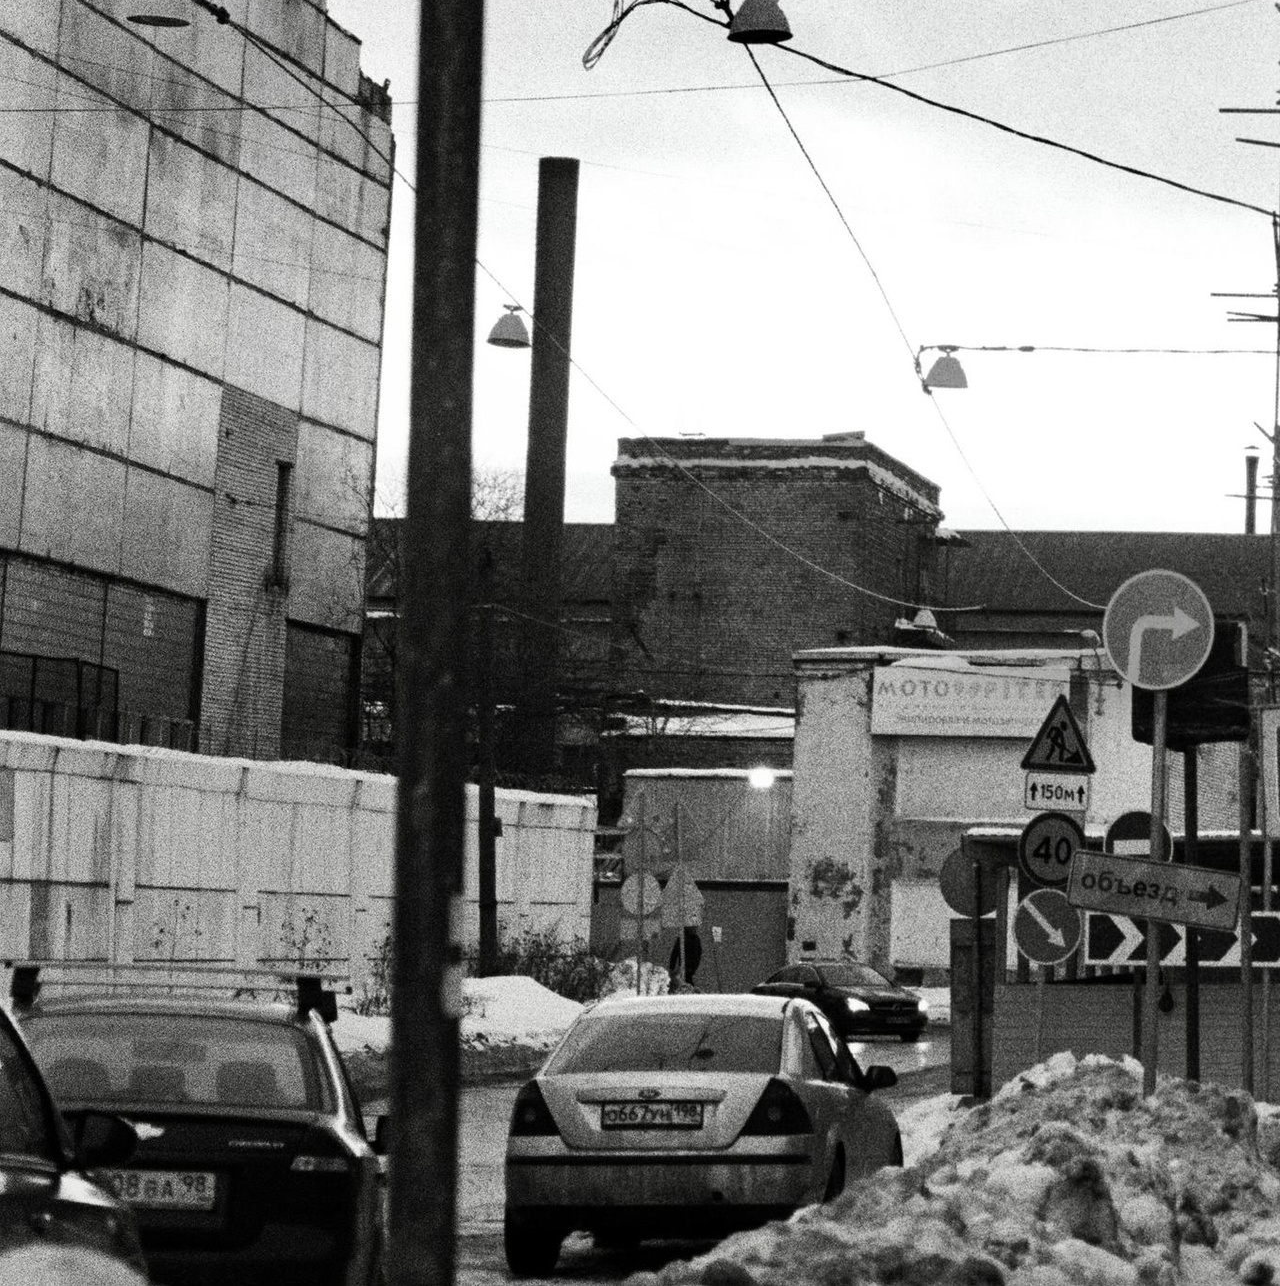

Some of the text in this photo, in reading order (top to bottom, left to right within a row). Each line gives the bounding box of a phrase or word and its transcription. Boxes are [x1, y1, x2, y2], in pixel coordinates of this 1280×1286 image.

[1033, 836, 1072, 866] 40
[1081, 869, 1179, 907] объезд
[182, 1174, 208, 1194] 98
